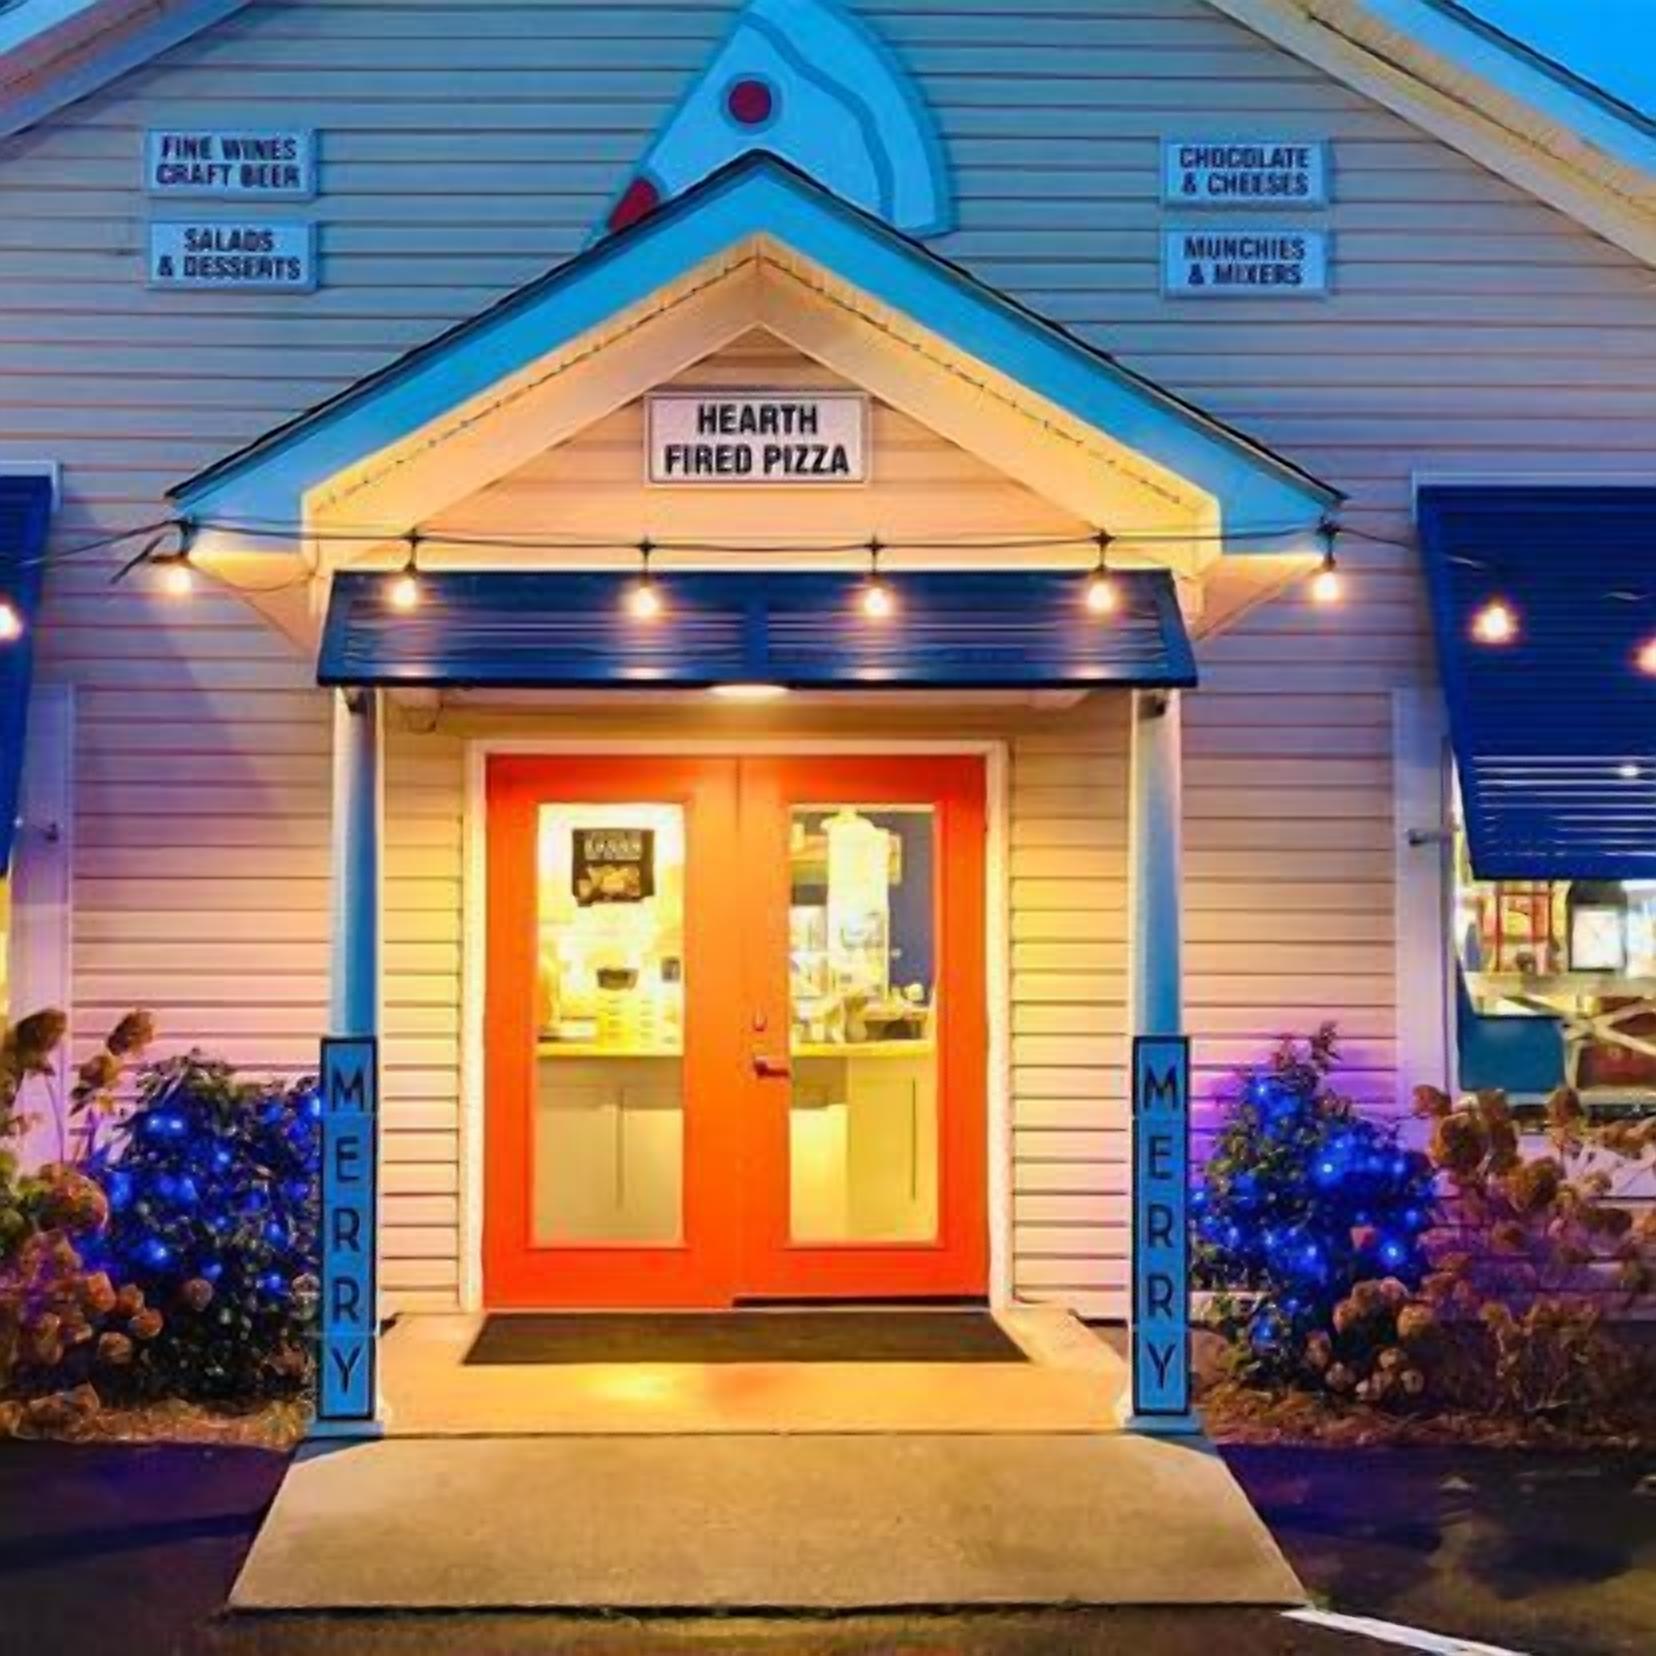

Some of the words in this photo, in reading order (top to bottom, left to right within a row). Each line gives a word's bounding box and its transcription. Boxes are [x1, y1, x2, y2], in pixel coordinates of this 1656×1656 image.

[162, 135, 212, 159] FINE
[221, 136, 297, 160] WINES
[1180, 147, 1310, 168] CHOCOLATE
[156, 163, 232, 185] CRAFT
[240, 165, 300, 188] BEER
[1182, 172, 1197, 193] &
[1208, 172, 1309, 195] CHEESES
[184, 227, 273, 252] SALADS
[1184, 236, 1306, 260] MUNCHIES
[157, 254, 174, 277] &
[183, 255, 301, 280] DESSERTS
[1188, 263, 1204, 285] &
[1214, 264, 1303, 285] MIXERS
[698, 404, 817, 435] HEARTH
[665, 444, 752, 475] FIRED
[763, 444, 850, 475] PIZZA
[331, 1065, 364, 1394] MERRY
[1143, 1063, 1178, 1390] MERRY
